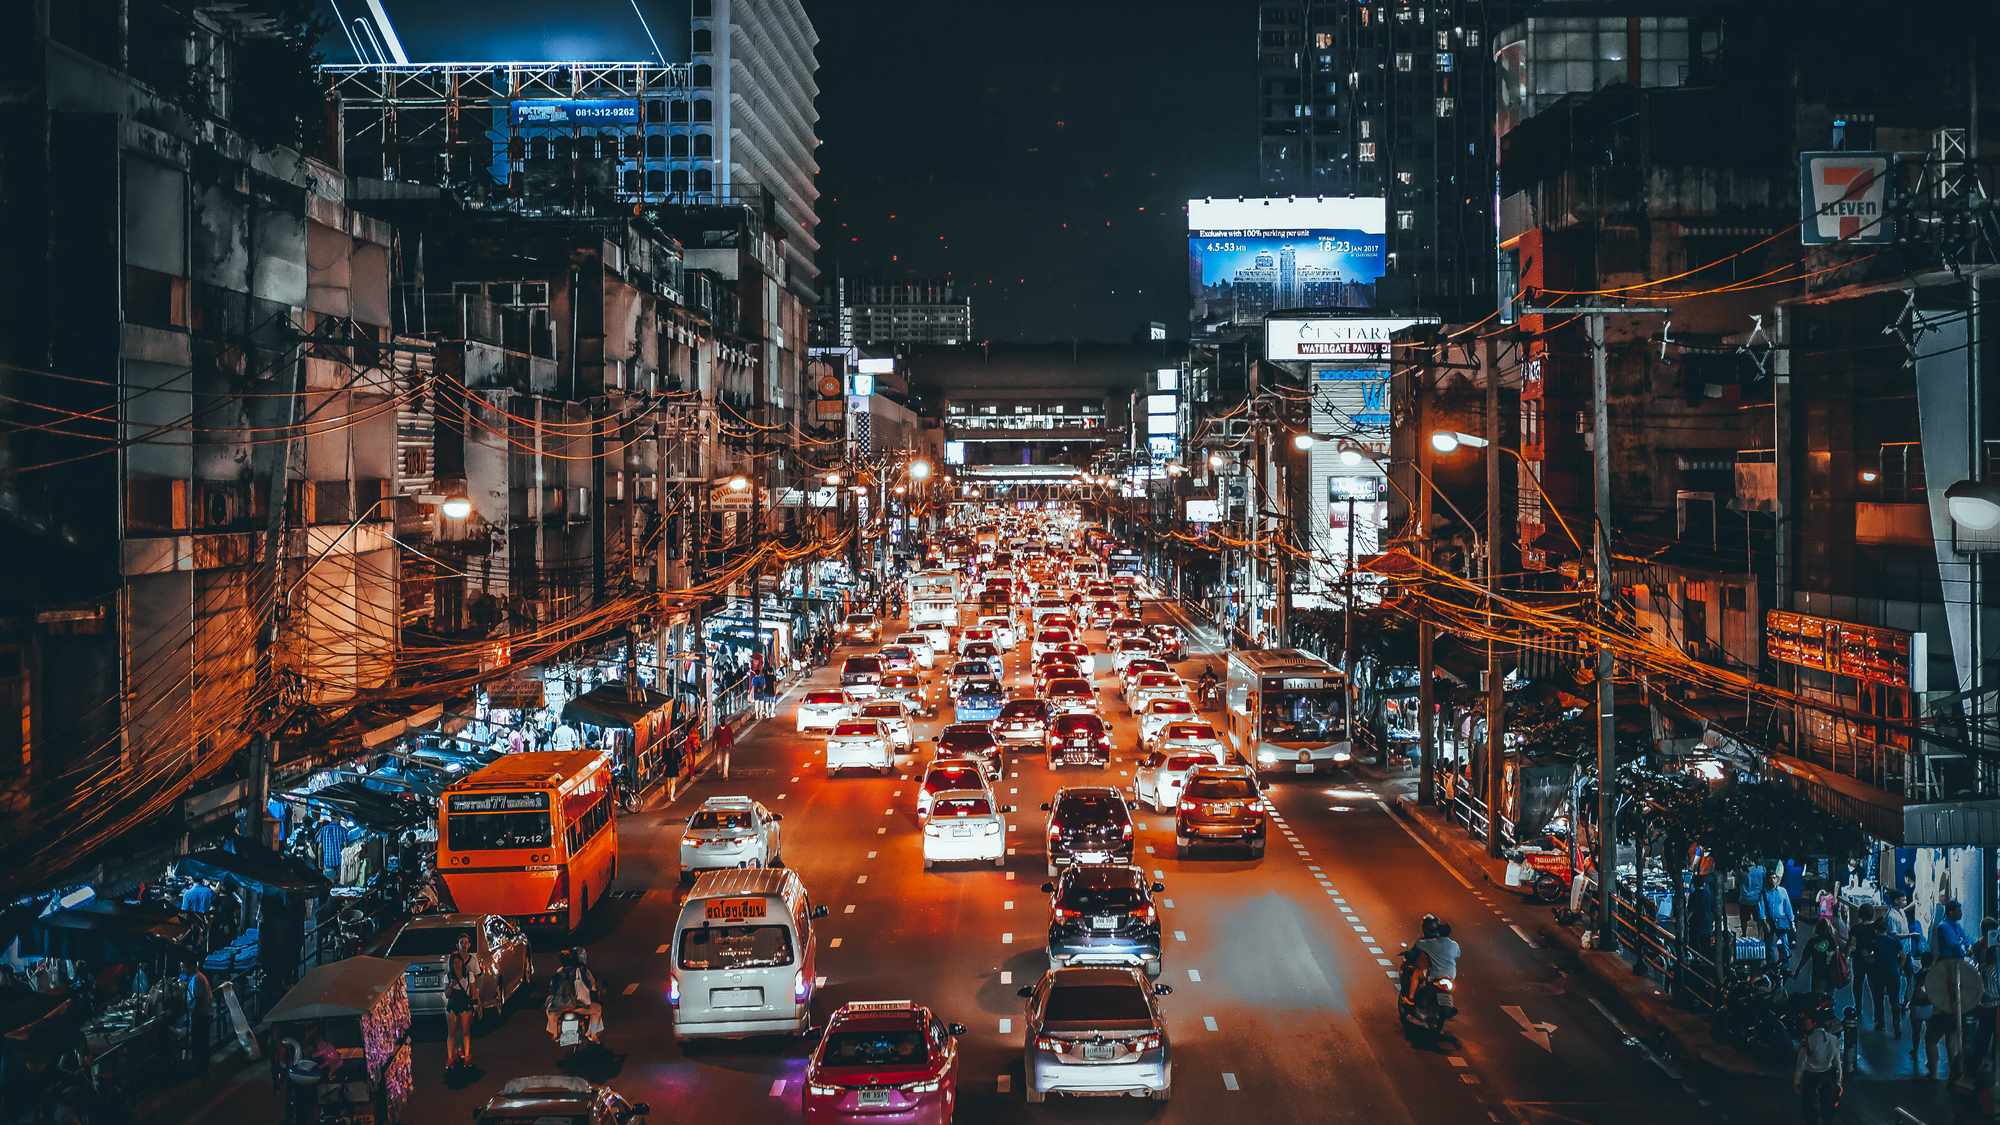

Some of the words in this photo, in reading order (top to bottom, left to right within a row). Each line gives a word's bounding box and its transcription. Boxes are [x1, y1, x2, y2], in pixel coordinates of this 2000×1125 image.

[575, 108, 635, 117] 081-312-9262
[1199, 230, 1228, 238] Exclusive
[1243, 230, 1262, 238] 100%
[1263, 231, 1286, 239] parking
[1207, 242, 1235, 252] 4.5-53
[1318, 240, 1350, 253] 18-23
[1351, 245, 1362, 253] JAN
[1302, 343, 1350, 353] WATERGATE
[514, 835, 542, 844] 77-12
